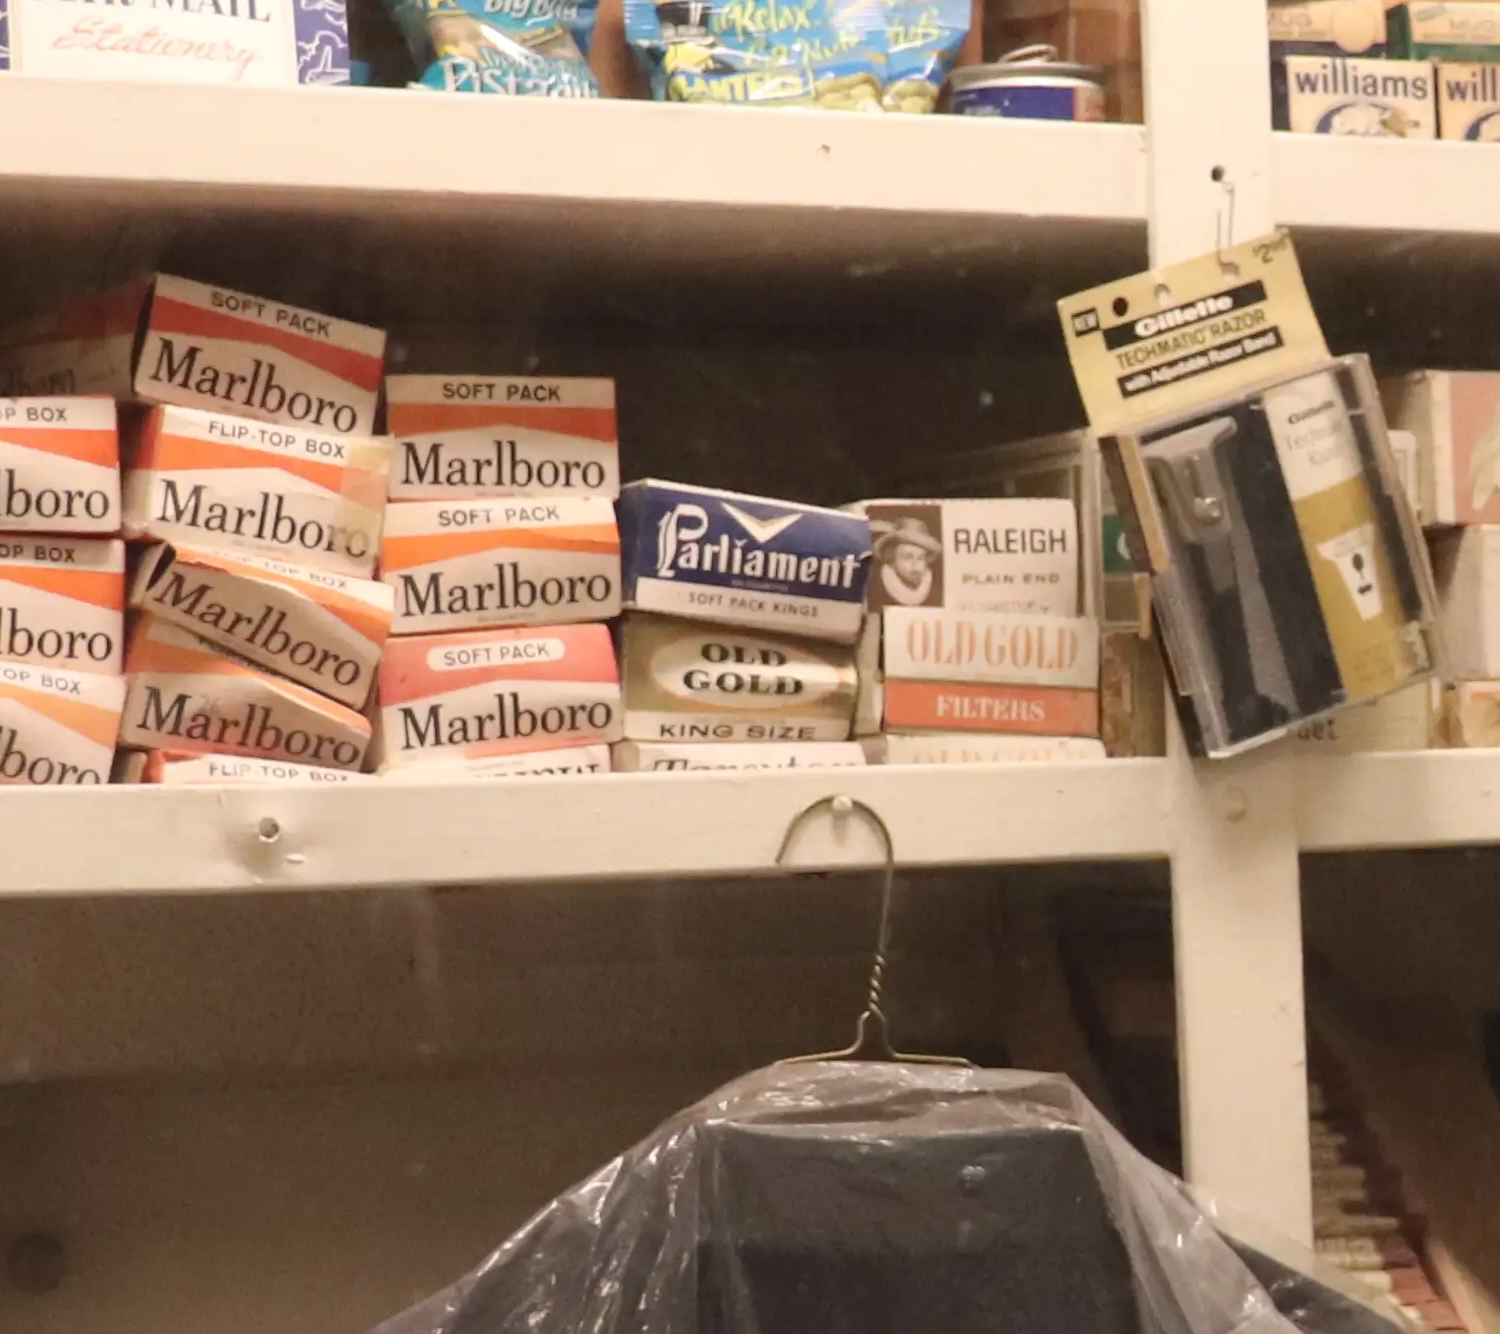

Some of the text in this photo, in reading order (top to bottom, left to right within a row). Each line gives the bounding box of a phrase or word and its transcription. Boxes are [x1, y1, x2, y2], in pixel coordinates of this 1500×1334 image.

[53, 15, 268, 82] Stationery
[1294, 56, 1428, 100] williams
[210, 289, 332, 338] SOFT PACK
[1134, 294, 1234, 338] Gillette
[1208, 308, 1268, 341] RAZOR
[148, 337, 359, 435] Marlboro
[442, 382, 561, 402] SOFT PACK
[25, 406, 69, 423] BOX
[305, 437, 346, 460] BOX
[401, 440, 606, 490] Marlboro
[157, 477, 370, 559] Marlboro
[437, 504, 561, 527] SOFT PACK
[33, 544, 77, 564] BOX
[656, 502, 870, 589] Parliament
[952, 527, 1068, 555] RALEIGH
[399, 563, 612, 619] Marlboro
[961, 572, 1061, 586] PLAIN END
[688, 590, 819, 619] SOFT PACK KINGS
[153, 569, 363, 689] Marlboro
[443, 642, 551, 667] SOFT PACK
[700, 641, 788, 667] OLD
[904, 619, 1079, 671] OLD GOLD
[40, 673, 83, 696] BOX
[682, 668, 805, 697] GOLD
[399, 690, 613, 752] Marlboro
[935, 694, 1047, 723] FILTERS
[135, 685, 361, 769] Marlboro
[658, 722, 818, 742] KING SIZE
